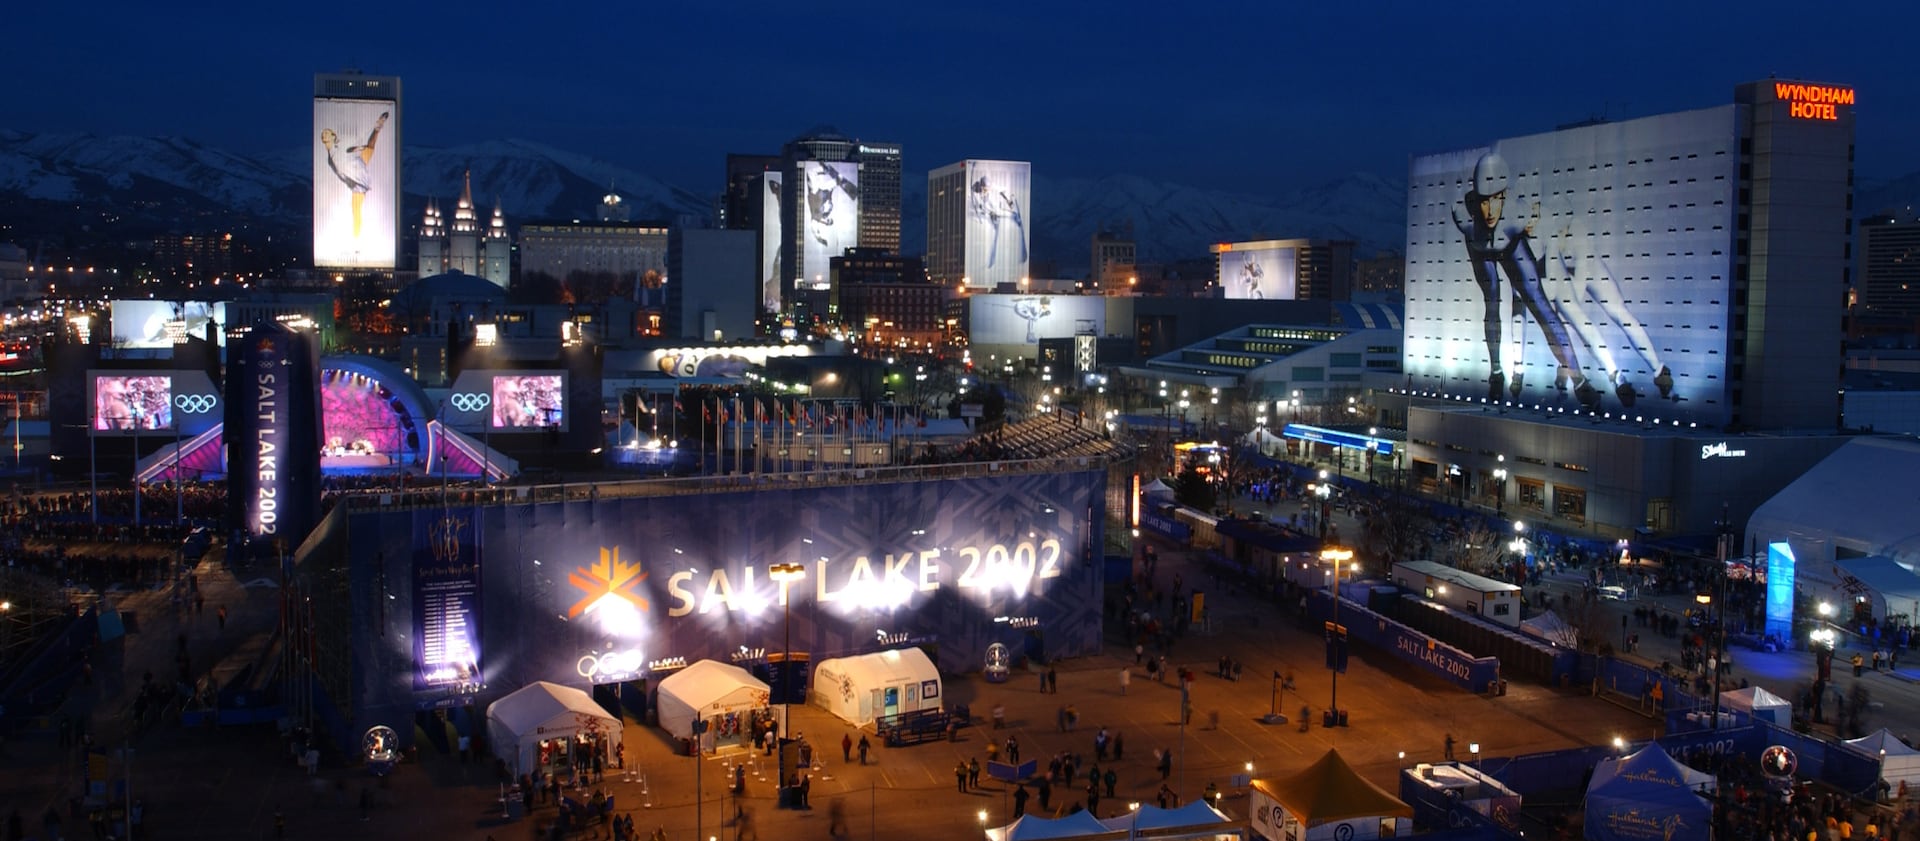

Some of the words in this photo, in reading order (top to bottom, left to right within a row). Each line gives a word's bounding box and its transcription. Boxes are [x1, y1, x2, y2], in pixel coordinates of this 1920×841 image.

[1775, 83, 1855, 104] WYNDHAM
[1790, 101, 1838, 120] HOTEL
[257, 373, 275, 424] SALT
[258, 429, 277, 481] LAKE
[259, 488, 277, 536] 2002
[667, 563, 798, 617] SALT
[816, 549, 940, 603] LAKE
[957, 538, 1061, 590] 2002
[1397, 635, 1420, 656] SALT
[1420, 642, 1444, 669] LAKE
[1447, 658, 1470, 681] 2002
[1622, 770, 1681, 788] Hallmark
[1607, 812, 1661, 829] Hallmark
